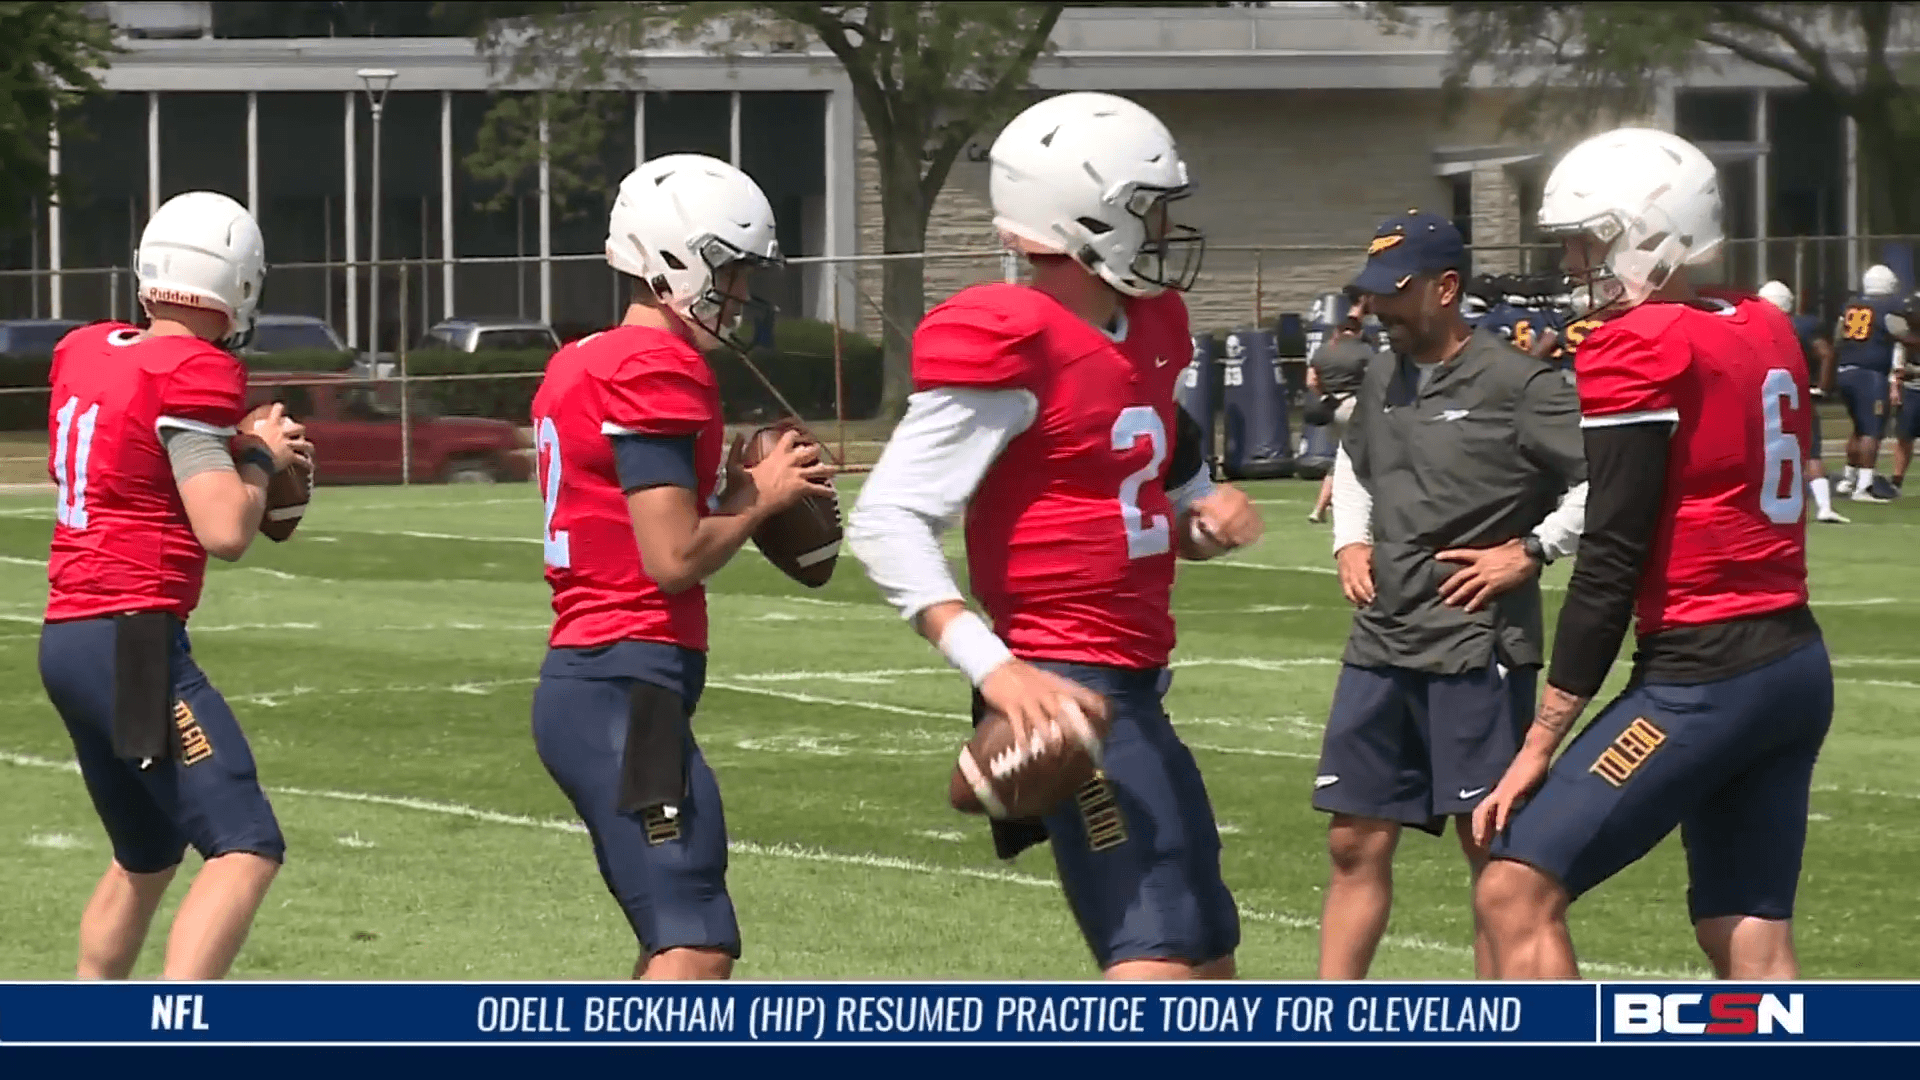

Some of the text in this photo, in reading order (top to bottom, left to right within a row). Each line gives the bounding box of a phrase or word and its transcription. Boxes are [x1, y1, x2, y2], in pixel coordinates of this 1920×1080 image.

[149, 286, 200, 305] Riddell
[53, 395, 100, 531] 11
[1110, 405, 1171, 560] 2
[1760, 367, 1804, 524] 6
[1588, 716, 1668, 788] TOLEDO
